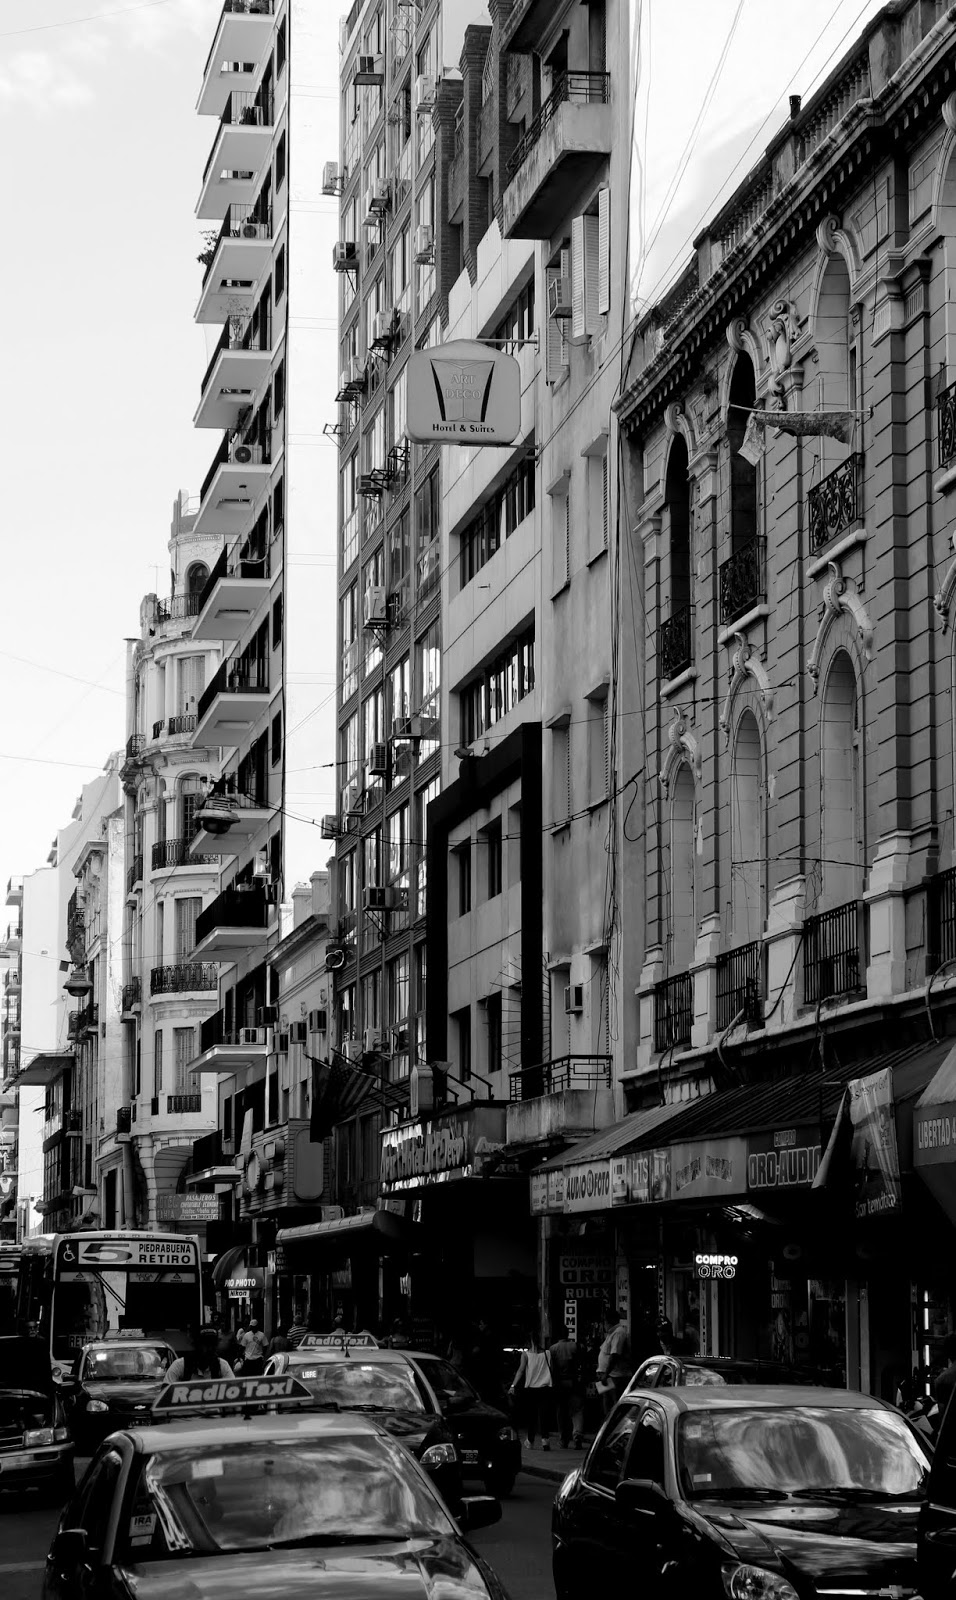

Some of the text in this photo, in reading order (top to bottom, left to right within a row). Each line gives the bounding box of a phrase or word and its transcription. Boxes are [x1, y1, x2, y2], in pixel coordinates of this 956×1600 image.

[451, 374, 477, 385] ART
[445, 388, 482, 399] DECO
[918, 1117, 951, 1149] LIBERTAD
[81, 1243, 133, 1262] 5
[139, 1243, 191, 1254] PIEDRABUENA
[139, 1254, 191, 1264] RETIRO
[562, 1257, 611, 1268] COMPRO
[695, 1253, 739, 1266] COMPRO
[563, 1269, 611, 1283] ORO
[697, 1264, 737, 1280] ORO
[235, 1278, 257, 1287] PHOTO
[565, 1287, 610, 1299] ROLEX
